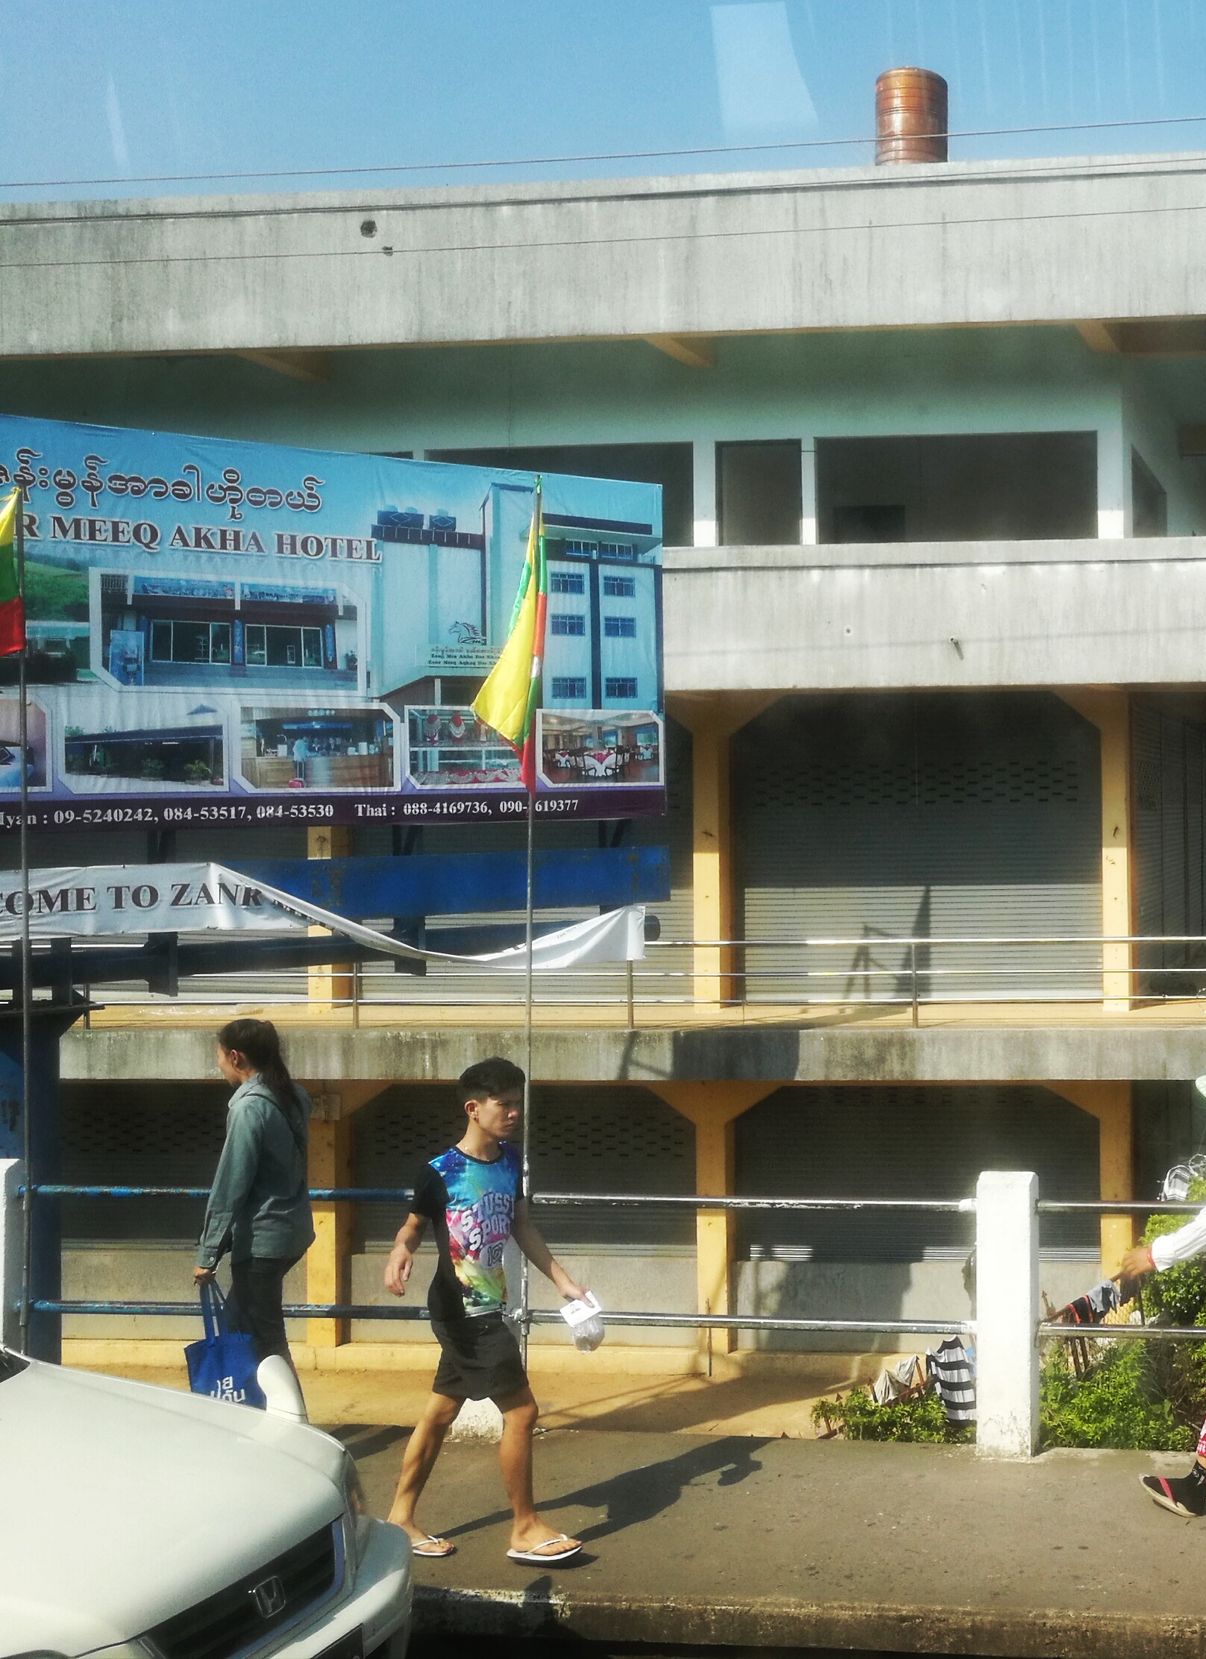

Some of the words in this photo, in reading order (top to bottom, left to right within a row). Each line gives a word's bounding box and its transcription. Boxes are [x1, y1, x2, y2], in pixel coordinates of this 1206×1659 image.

[50, 515, 160, 552] MEEQ
[169, 524, 267, 554] AKHA
[275, 532, 382, 562] HOTEL
[53, 808, 159, 825] 09-5240242,
[163, 806, 252, 822] 084-53517,
[256, 804, 334, 819] 084-53530
[354, 803, 388, 817] Thai
[402, 801, 493, 816] 088-4169736,
[499, 800, 579, 814] 090-619377
[106, 884, 160, 910] TO
